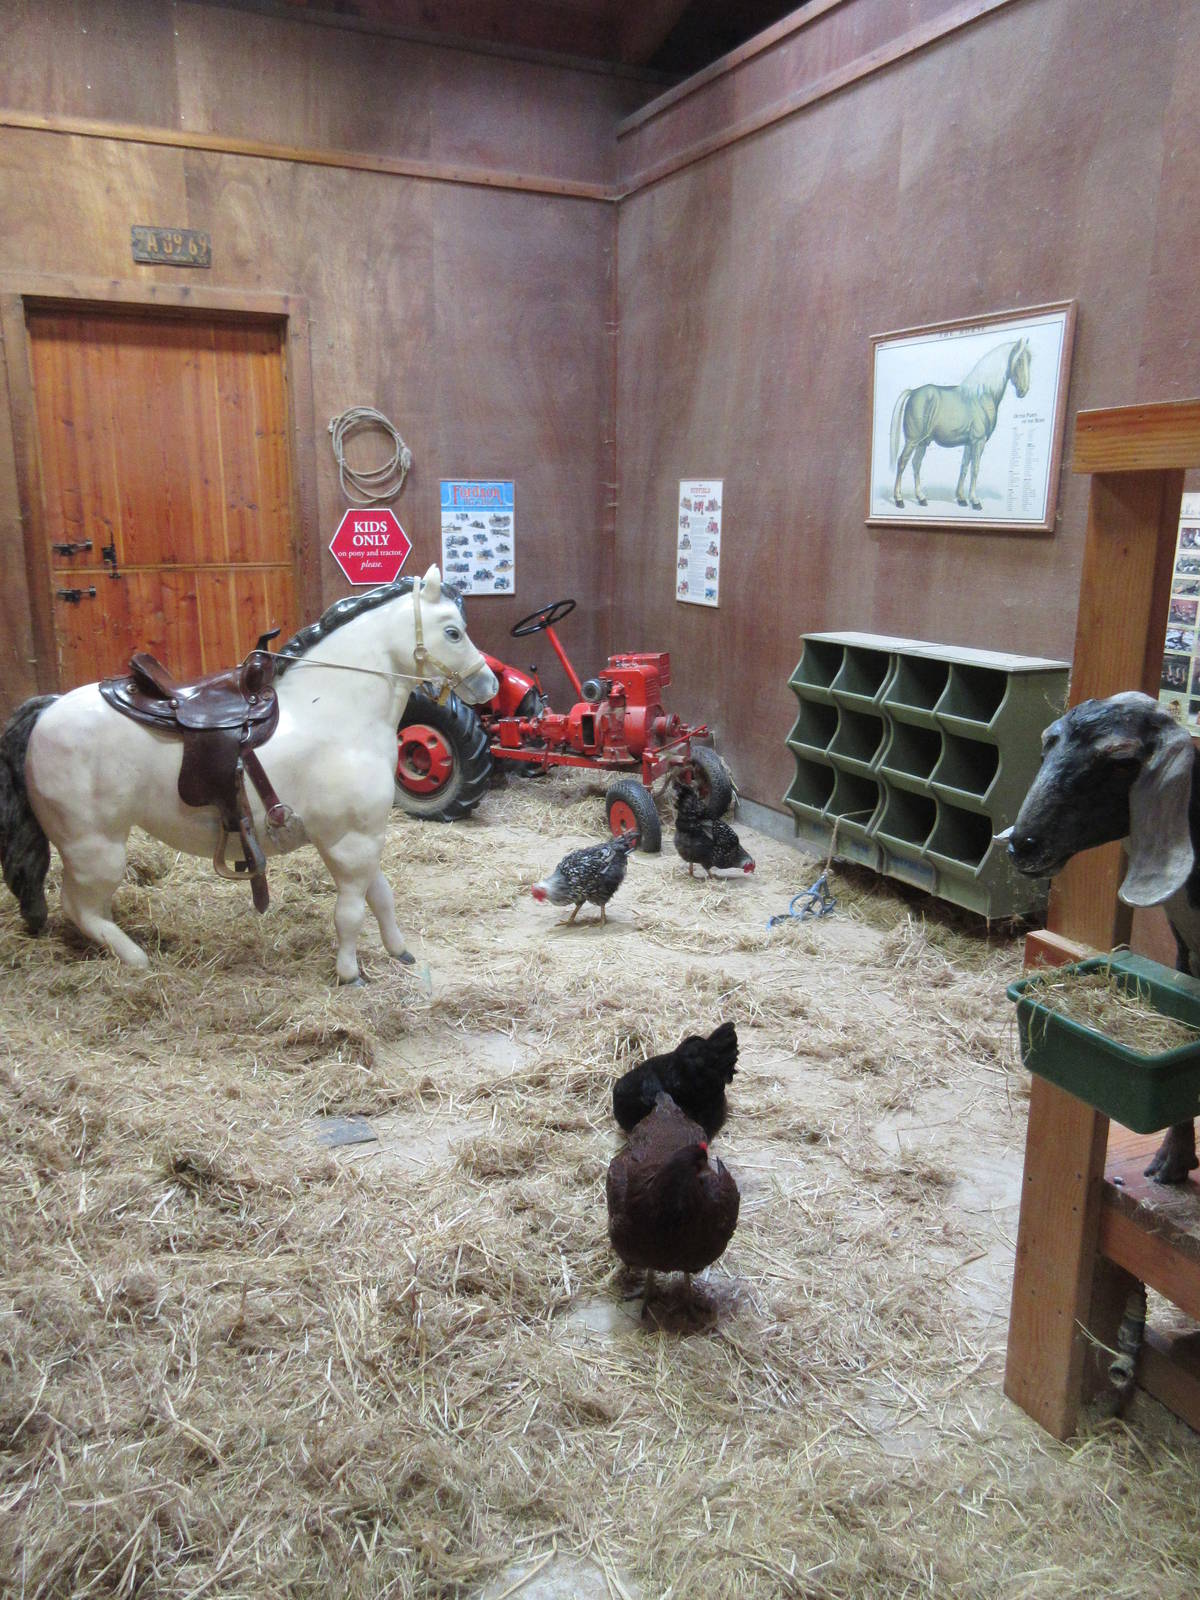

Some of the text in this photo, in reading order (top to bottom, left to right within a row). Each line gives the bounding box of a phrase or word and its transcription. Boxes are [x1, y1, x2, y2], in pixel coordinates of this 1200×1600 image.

[353, 520, 388, 533] KIDS
[352, 534, 390, 547] ONLY
[348, 551, 365, 559] pony
[360, 560, 384, 571] please.
